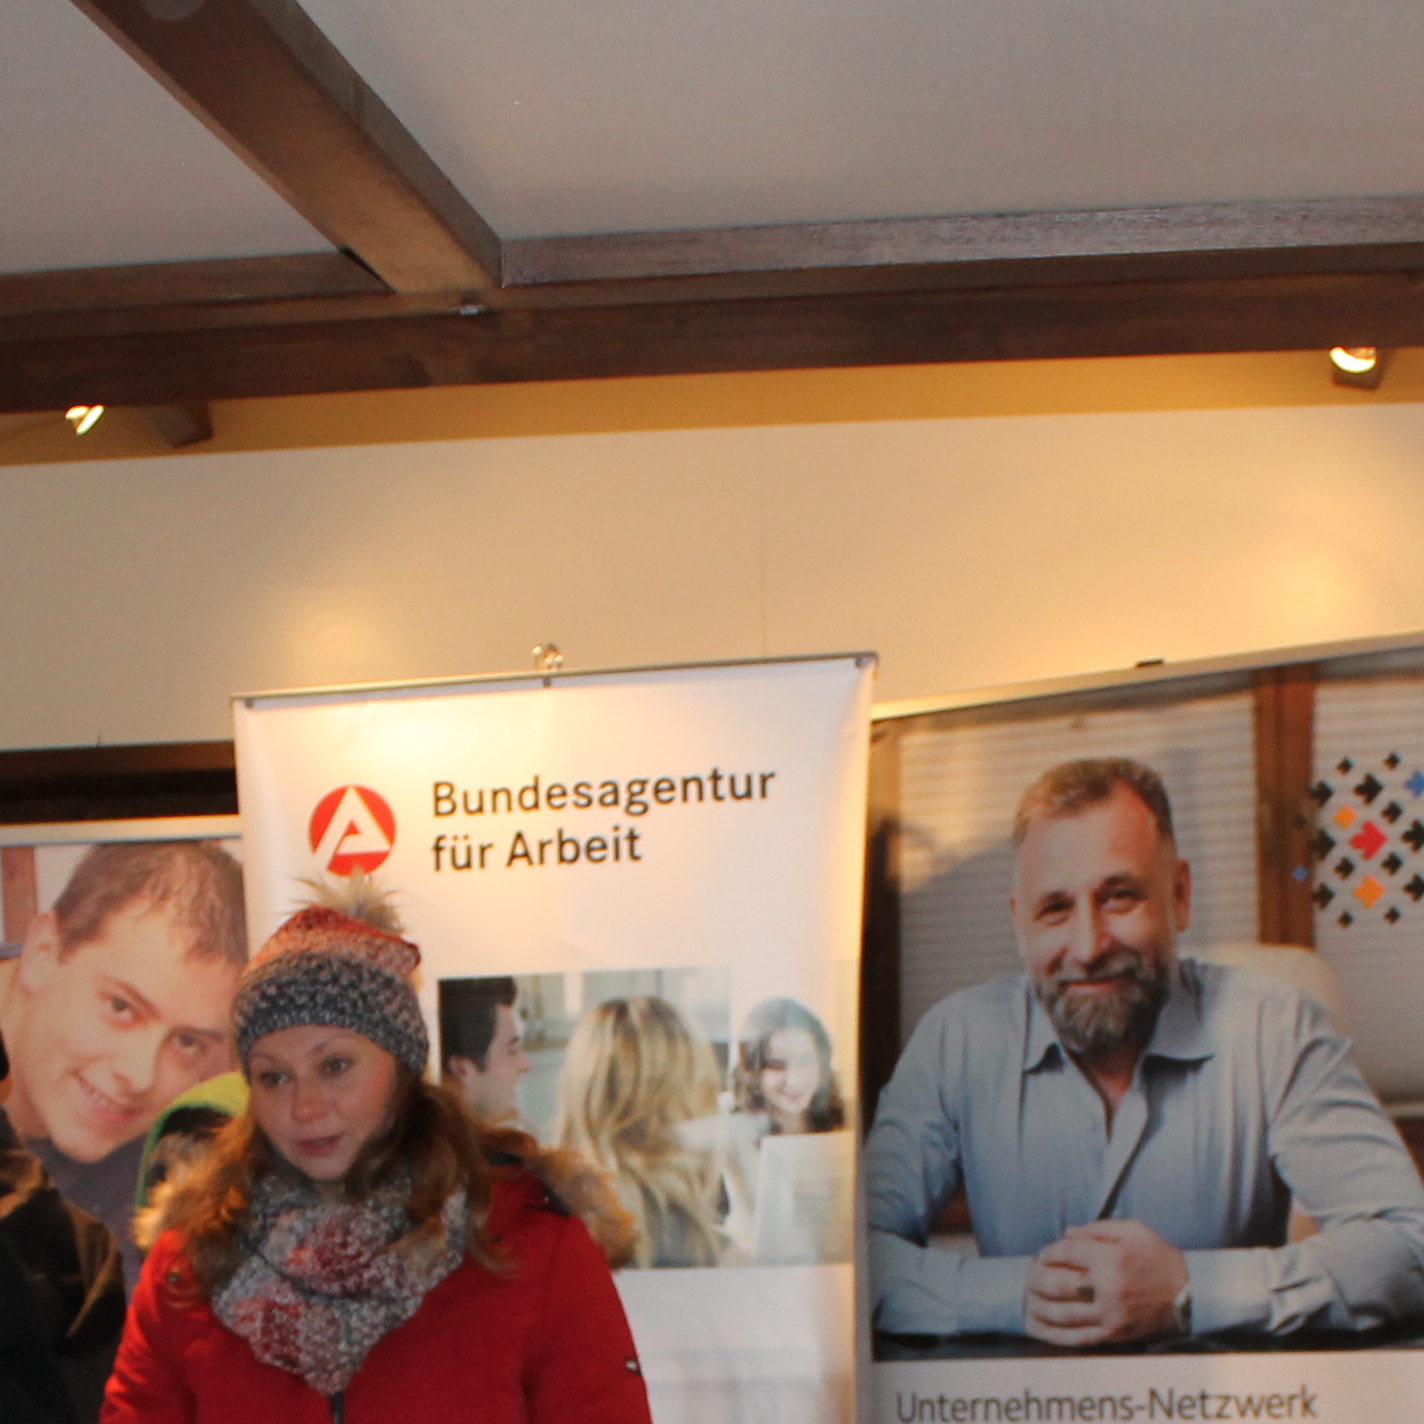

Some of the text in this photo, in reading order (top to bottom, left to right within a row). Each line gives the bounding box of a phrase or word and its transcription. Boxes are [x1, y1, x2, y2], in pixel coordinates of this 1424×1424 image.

[432, 767, 776, 817] Bundesagentur
[432, 824, 643, 872] für Arbeit
[896, 1384, 1319, 1423] Unternehmens-Netzwerk
